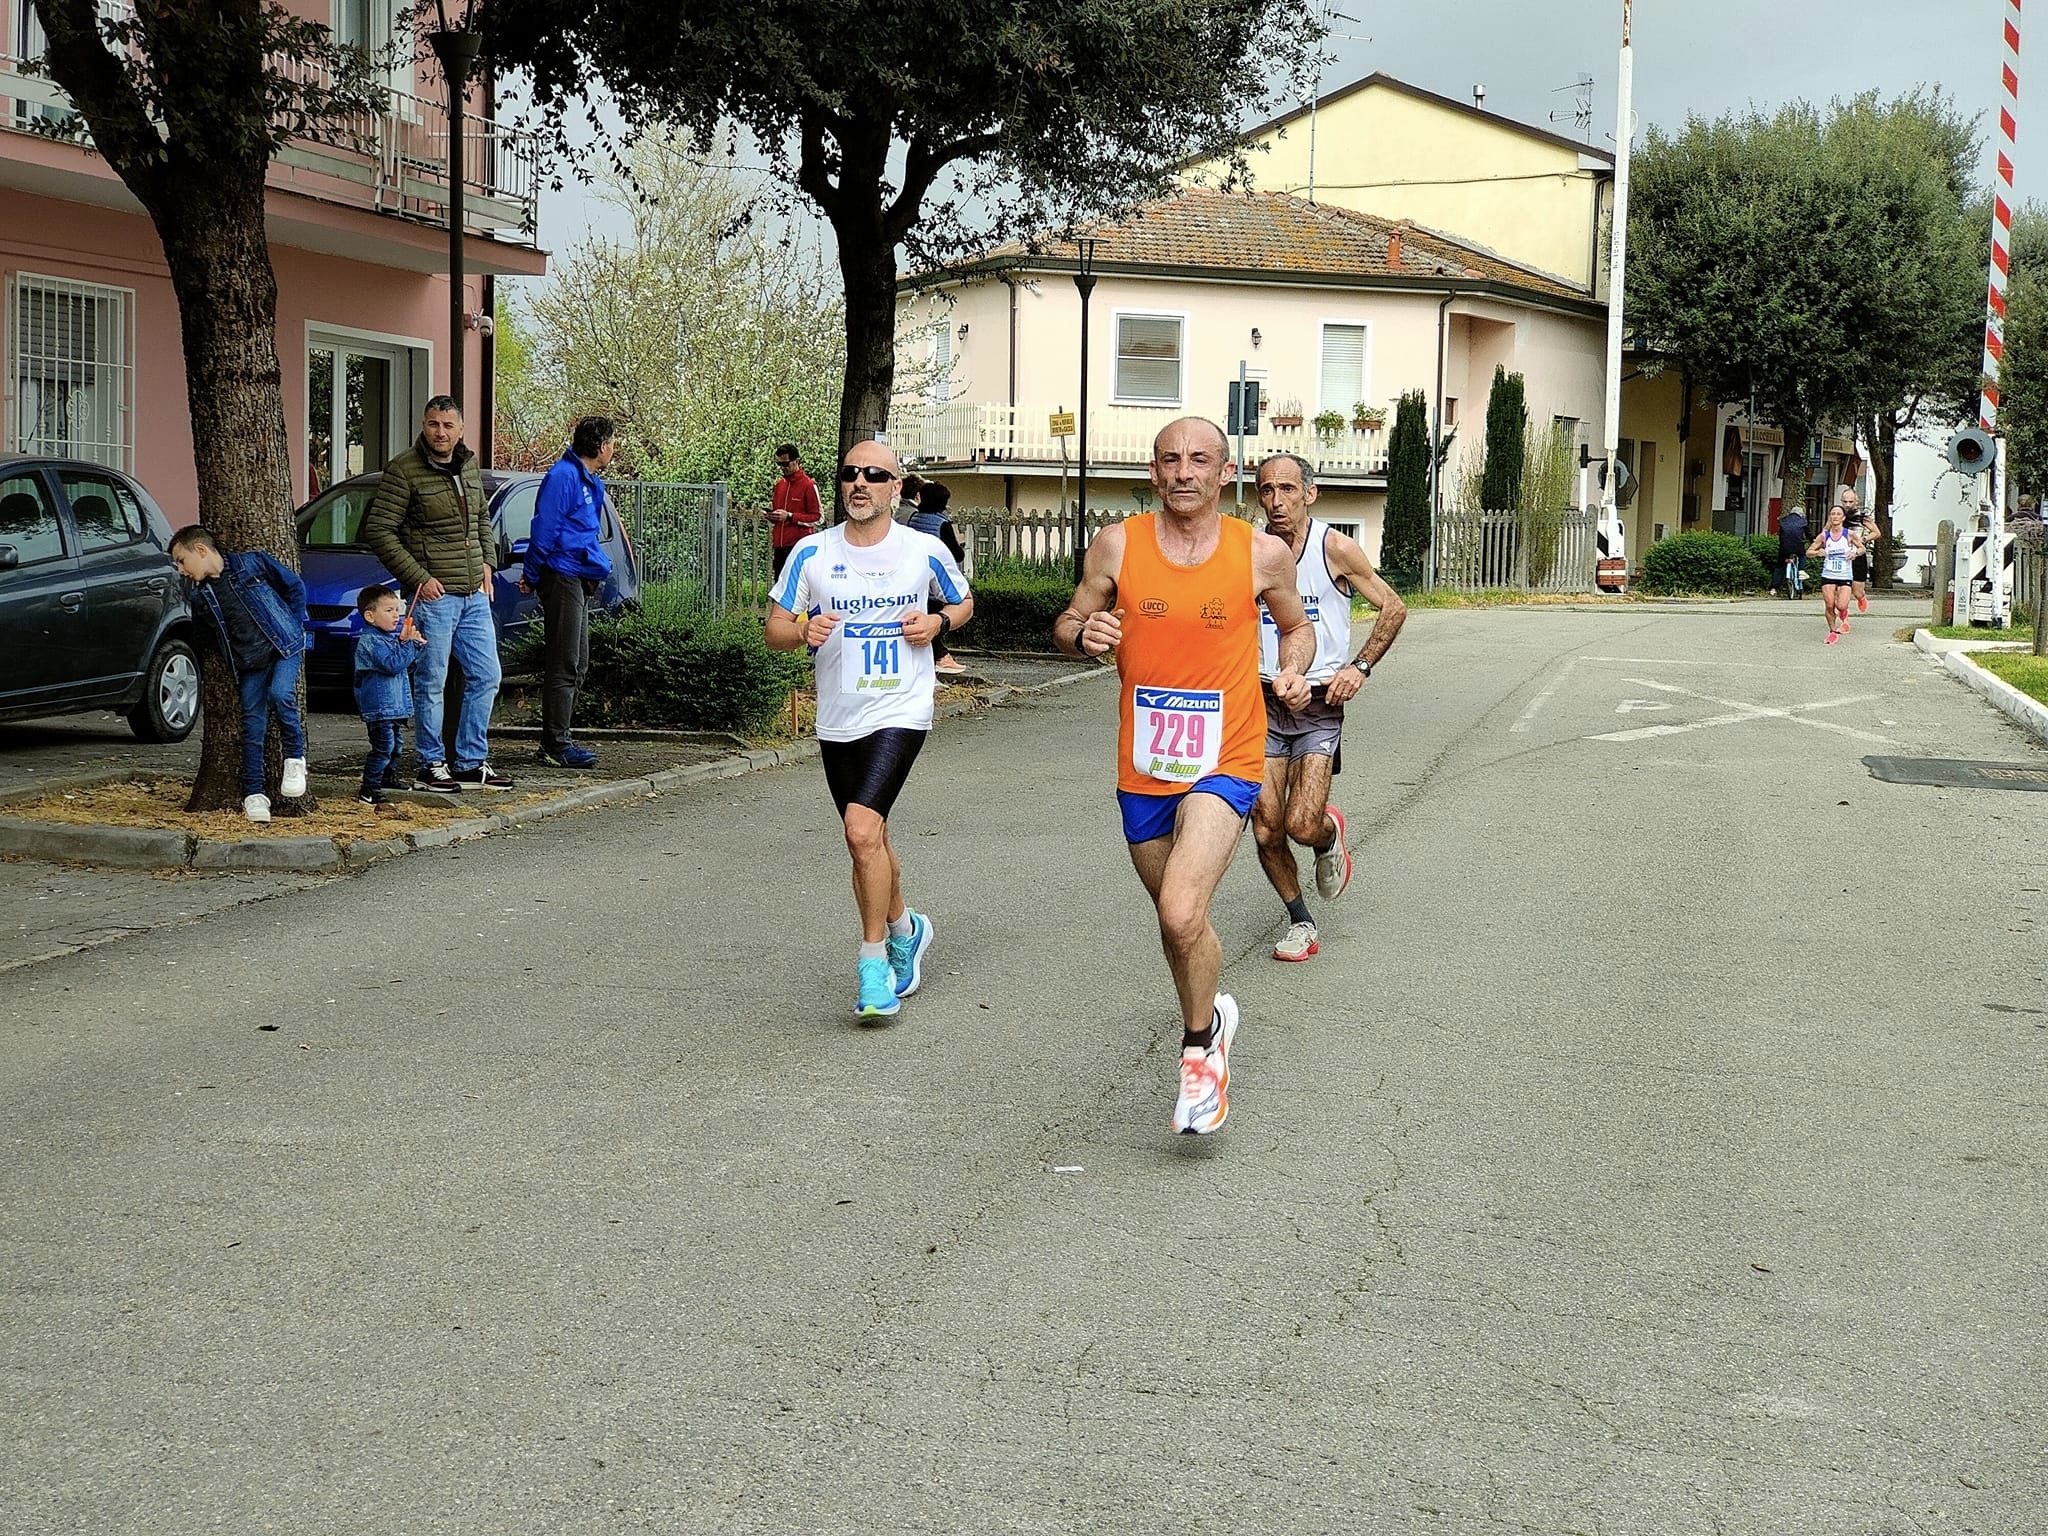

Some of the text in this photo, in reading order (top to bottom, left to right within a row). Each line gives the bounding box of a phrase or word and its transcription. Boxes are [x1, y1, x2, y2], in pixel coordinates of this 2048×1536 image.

[831, 594, 918, 614] lughesina
[1143, 602, 1164, 610] LUCCI
[862, 640, 899, 675] 141
[1149, 711, 1205, 758] 229
